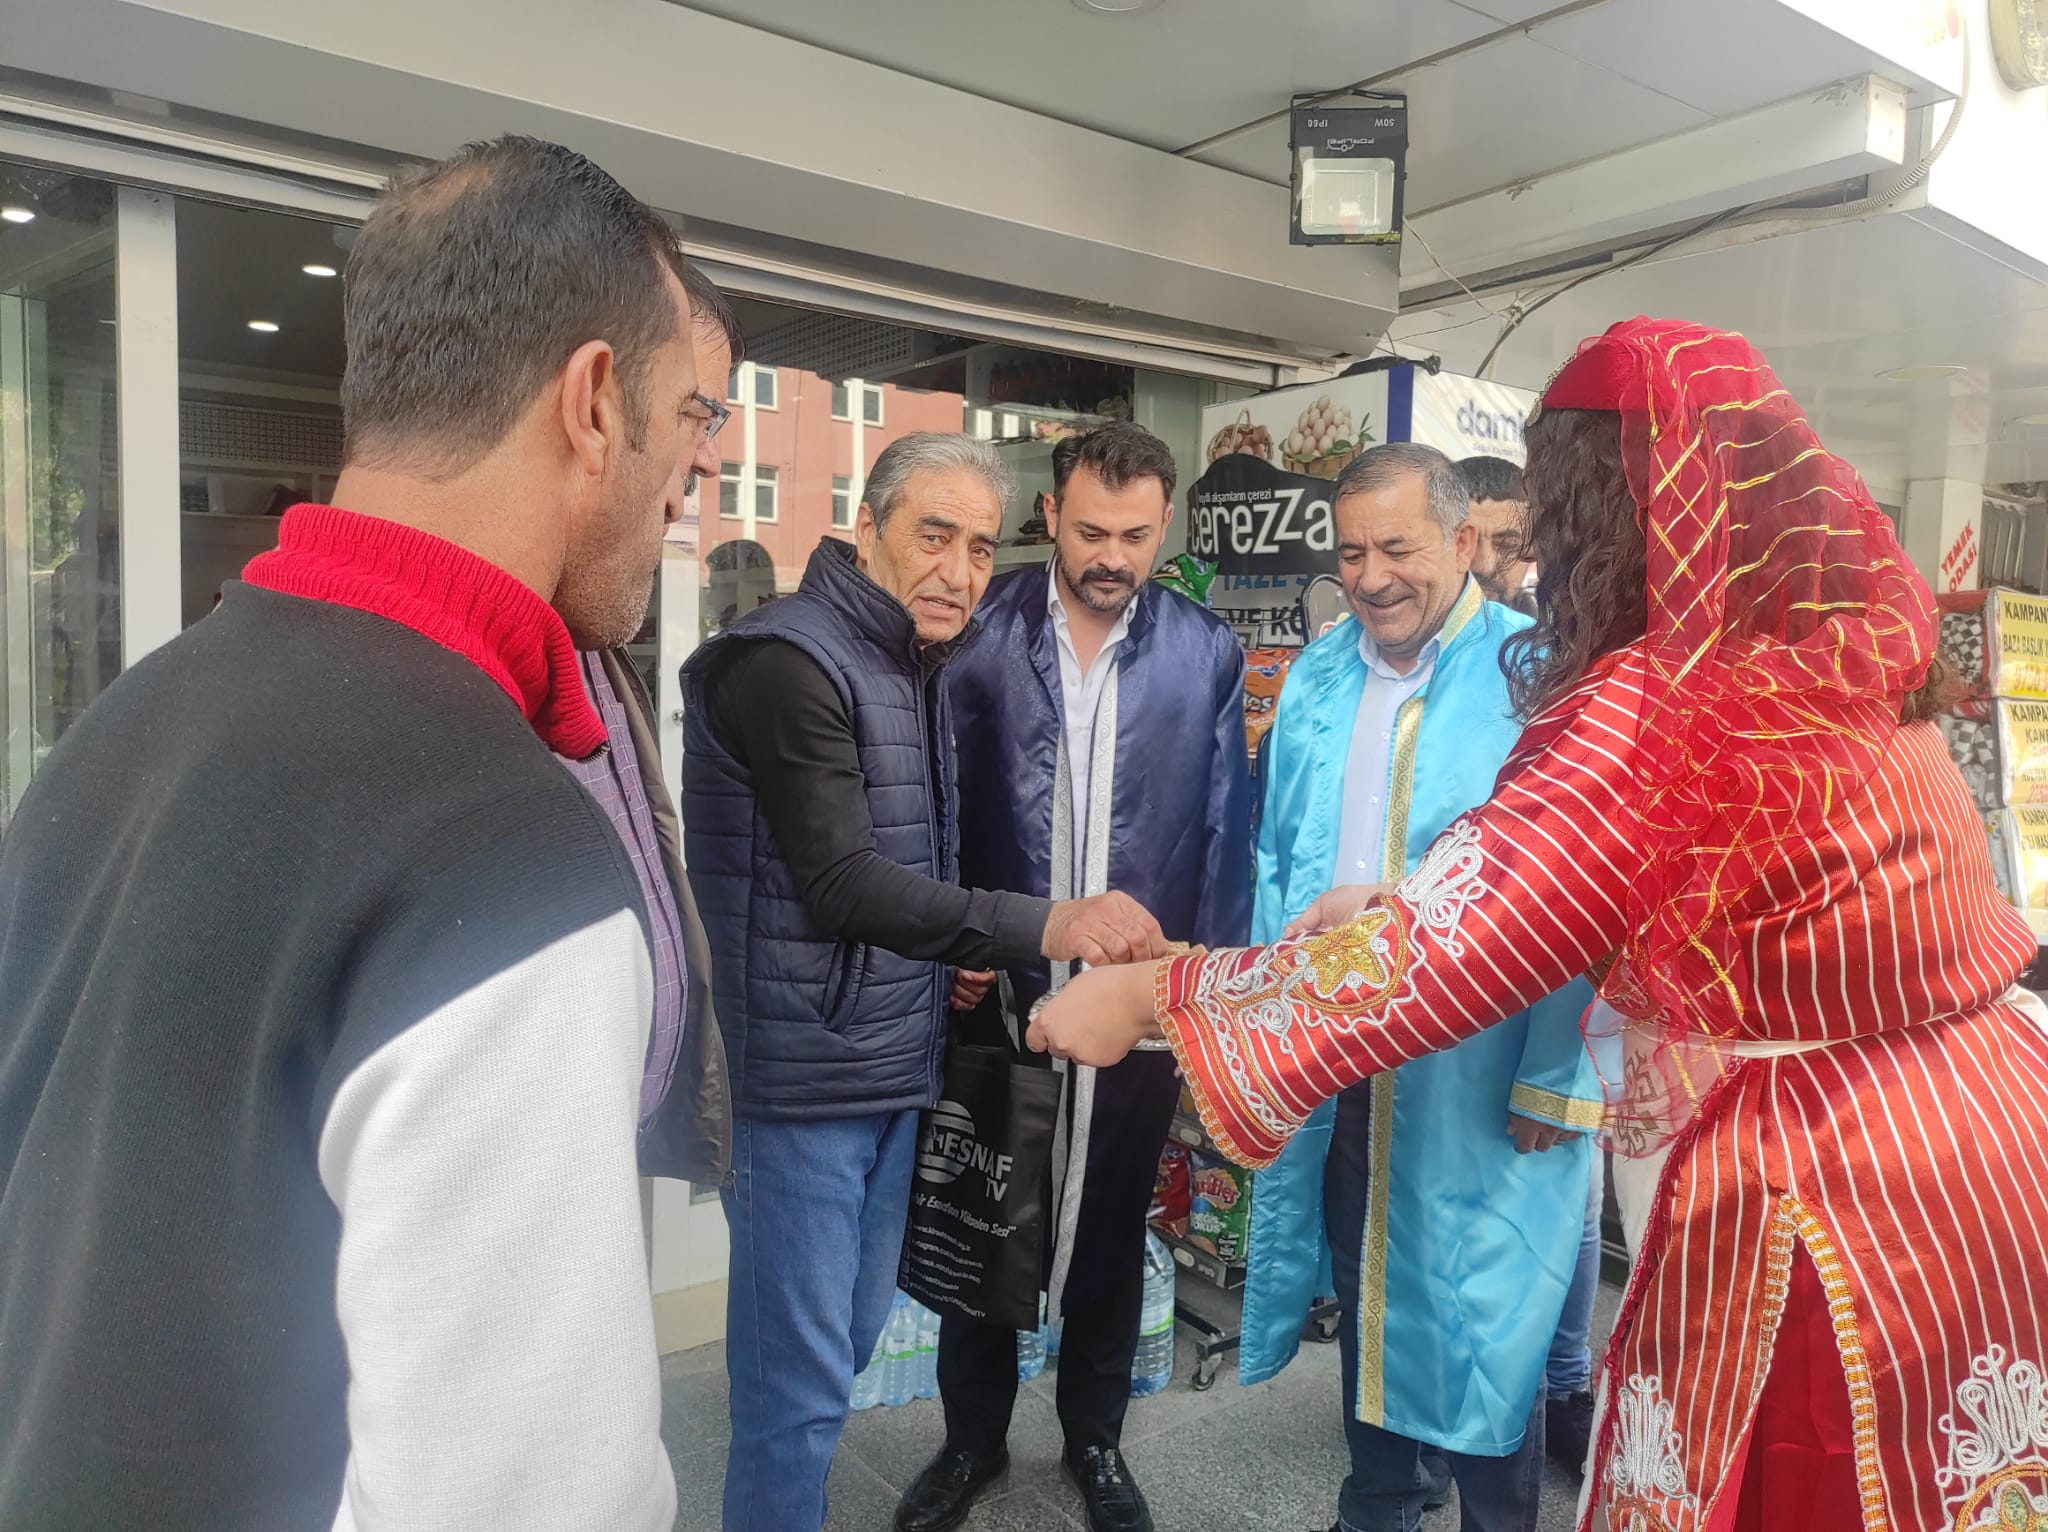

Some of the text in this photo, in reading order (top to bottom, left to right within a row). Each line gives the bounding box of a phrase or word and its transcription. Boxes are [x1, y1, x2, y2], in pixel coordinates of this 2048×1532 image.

[1307, 119, 1328, 128] IP66
[1374, 118, 1395, 127] 50W
[1247, 488, 1272, 504] çerezi
[1941, 520, 1974, 575] YEMEK
[1949, 541, 1977, 593] ODASI
[1271, 597, 1304, 636] KÖ
[2004, 601, 2048, 625] KAMPAN
[2009, 704, 2048, 722] KAMPA
[985, 1177, 1008, 1202] TV
